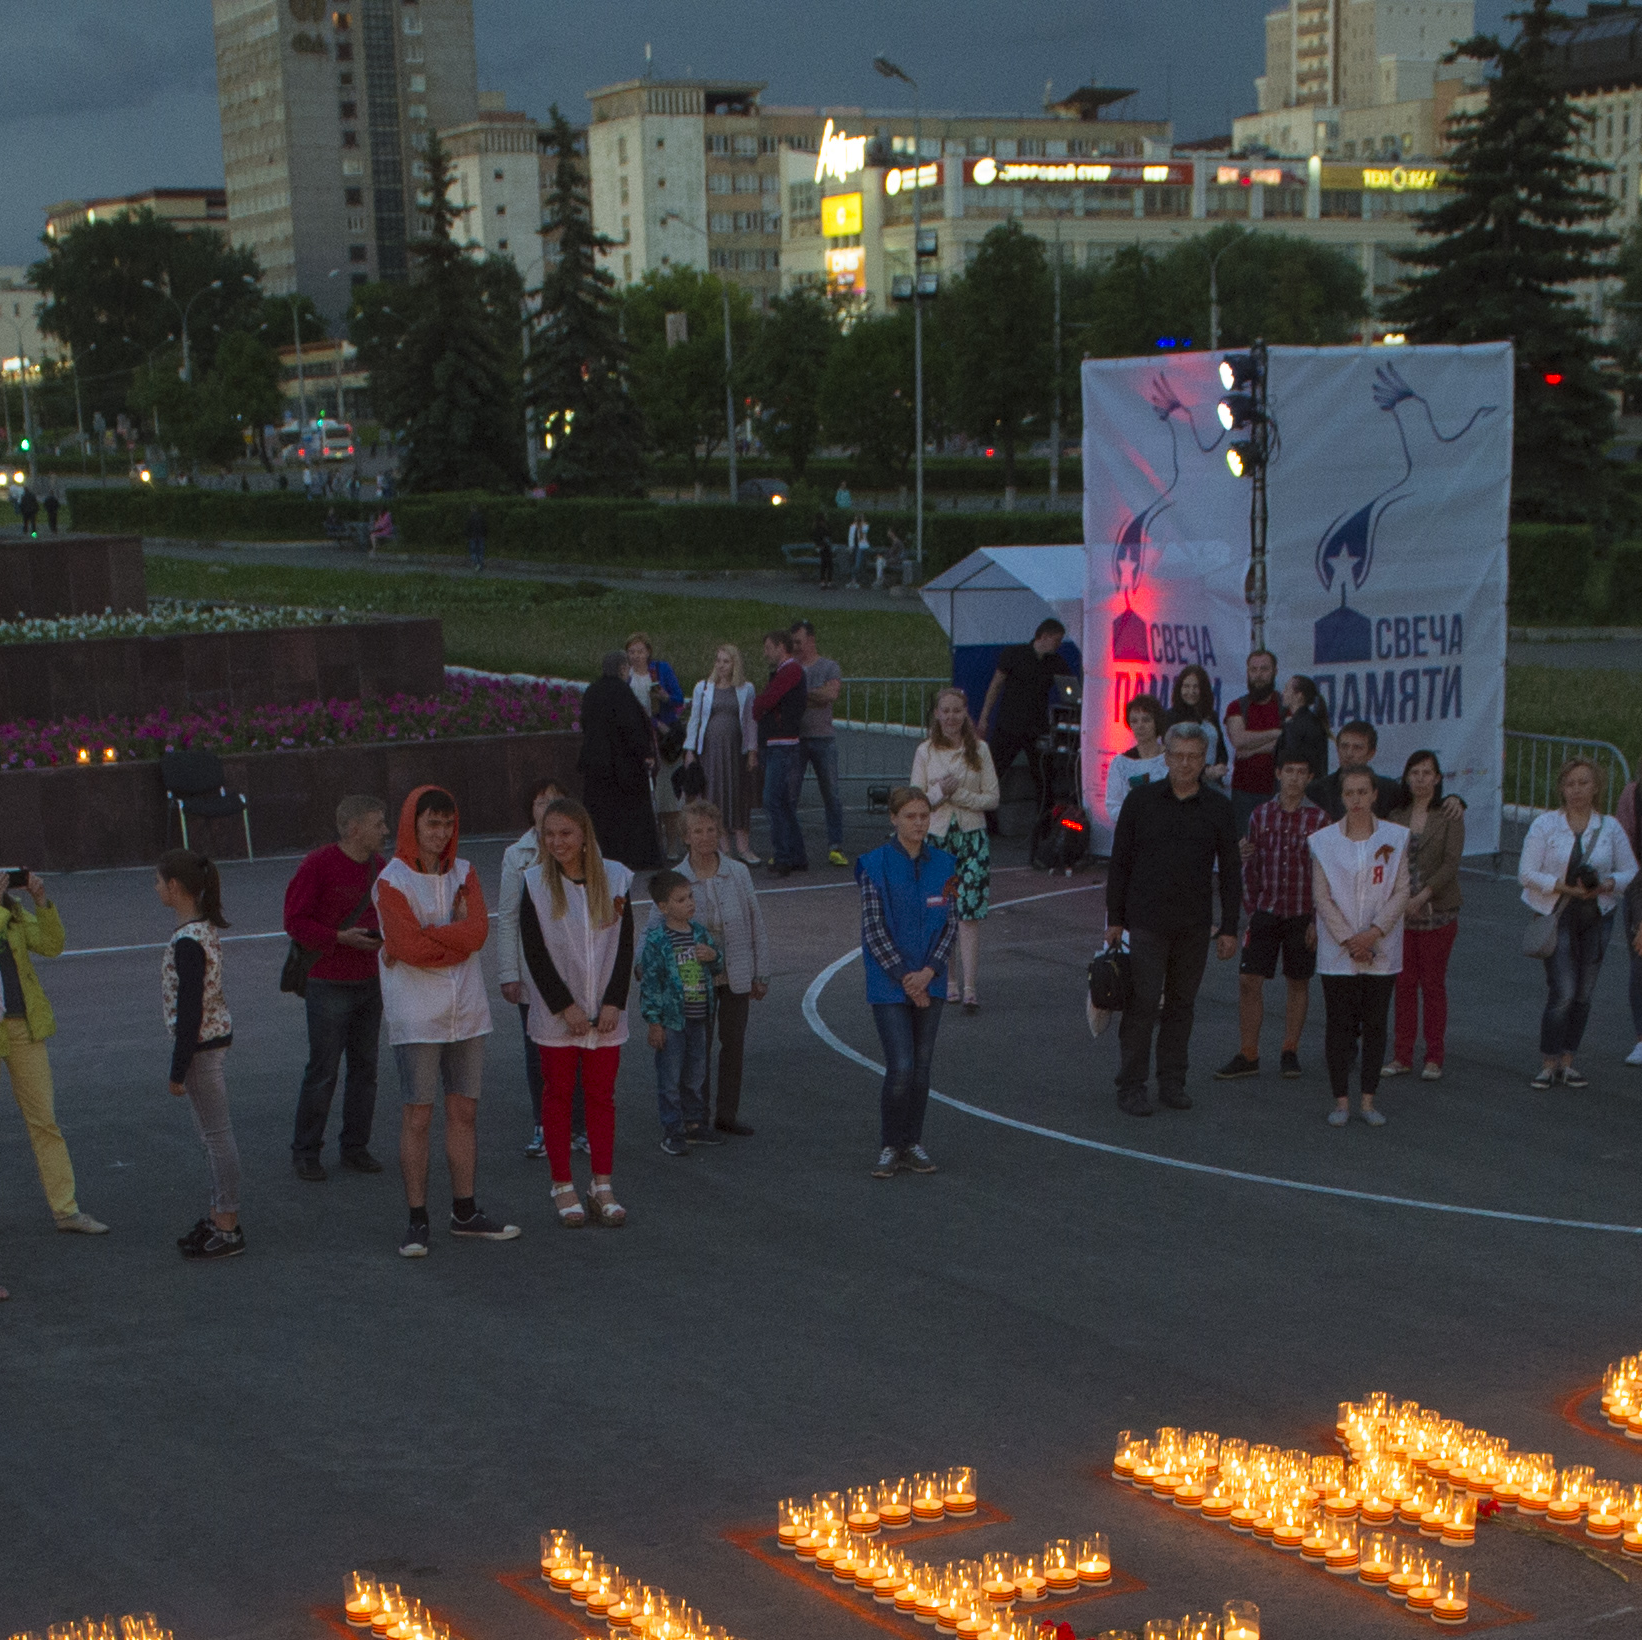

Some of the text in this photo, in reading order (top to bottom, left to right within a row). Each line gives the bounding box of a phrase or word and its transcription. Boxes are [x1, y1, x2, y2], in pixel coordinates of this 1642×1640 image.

[1150, 623, 1216, 667] СВЕЧА
[1376, 613, 1463, 660] СВЕЧА
[1312, 664, 1463, 729] ПАМЯТИ
[1372, 866, 1384, 885] Я
